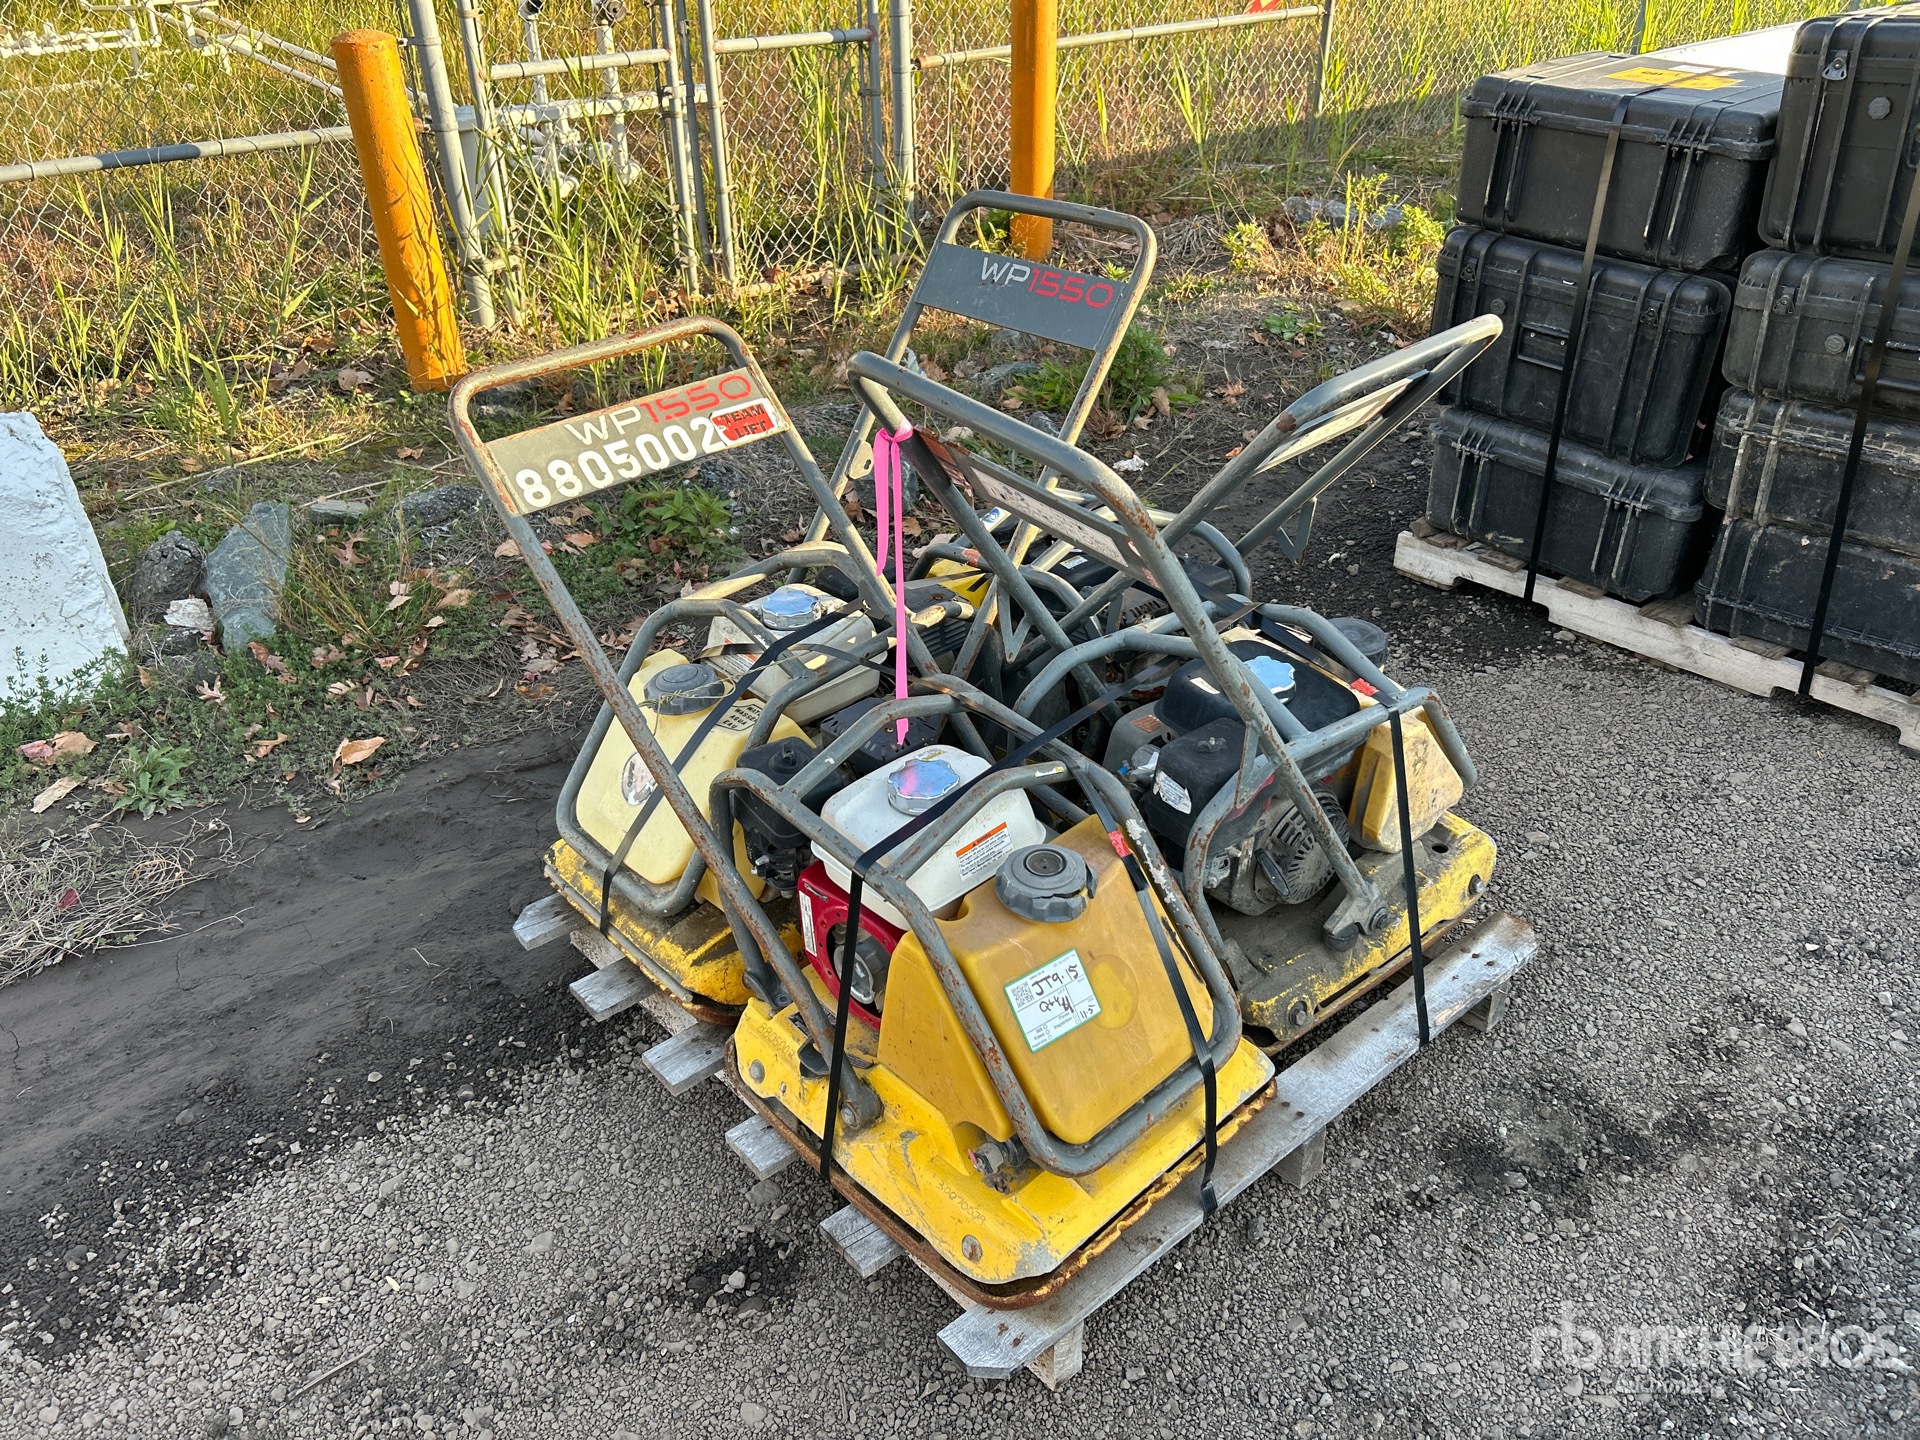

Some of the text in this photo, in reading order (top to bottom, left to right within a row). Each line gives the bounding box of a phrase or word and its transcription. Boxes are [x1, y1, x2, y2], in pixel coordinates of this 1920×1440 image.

[981, 257, 1114, 308] WP1550
[564, 375, 751, 445] WP1550
[722, 403, 765, 425] TEAM
[734, 420, 768, 439] LIFT
[515, 416, 728, 508] 8805002
[722, 720, 738, 729] EAU
[730, 714, 748, 726] AGUA
